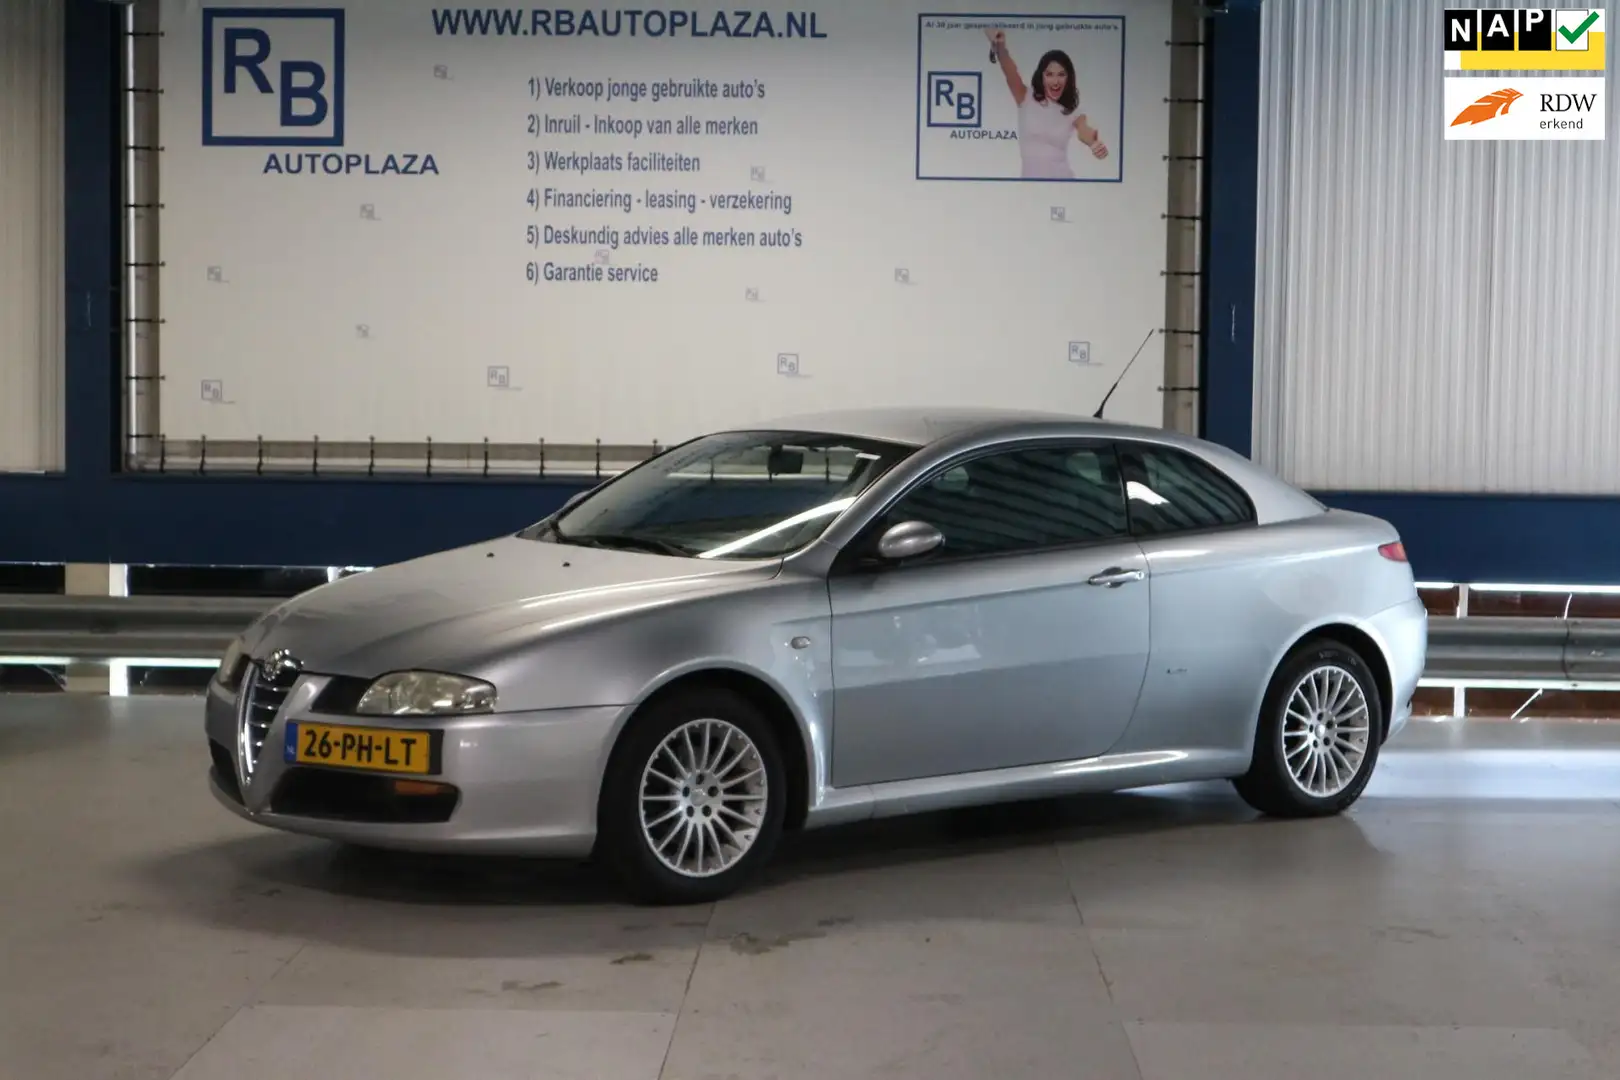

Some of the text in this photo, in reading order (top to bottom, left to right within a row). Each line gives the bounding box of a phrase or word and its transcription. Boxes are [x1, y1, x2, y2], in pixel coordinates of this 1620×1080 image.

[431, 9, 828, 38] WWW.RBAUTOPLAZA.NL
[528, 77, 765, 102] 1) Verkoop jonge gebruikte auto's
[527, 114, 540, 137] 2)
[545, 114, 581, 134] Inruil
[594, 115, 643, 138] Inkoop
[646, 120, 672, 134] van
[676, 116, 701, 135] alle
[705, 117, 758, 136] merken
[950, 129, 1018, 140] AUTOPLAZA
[263, 153, 440, 175] AUTOPLAZA
[527, 151, 700, 175] 3) Werkplaats faciliteiten
[526, 188, 540, 211] 4)
[544, 188, 632, 213] Financiering
[645, 190, 696, 214] leasing
[709, 191, 792, 215] verzekering
[526, 225, 802, 249] 5) Deskundig advies alle merken auto's
[526, 262, 658, 285] 6) Garantie service
[304, 730, 416, 766] 26-PH-LT
